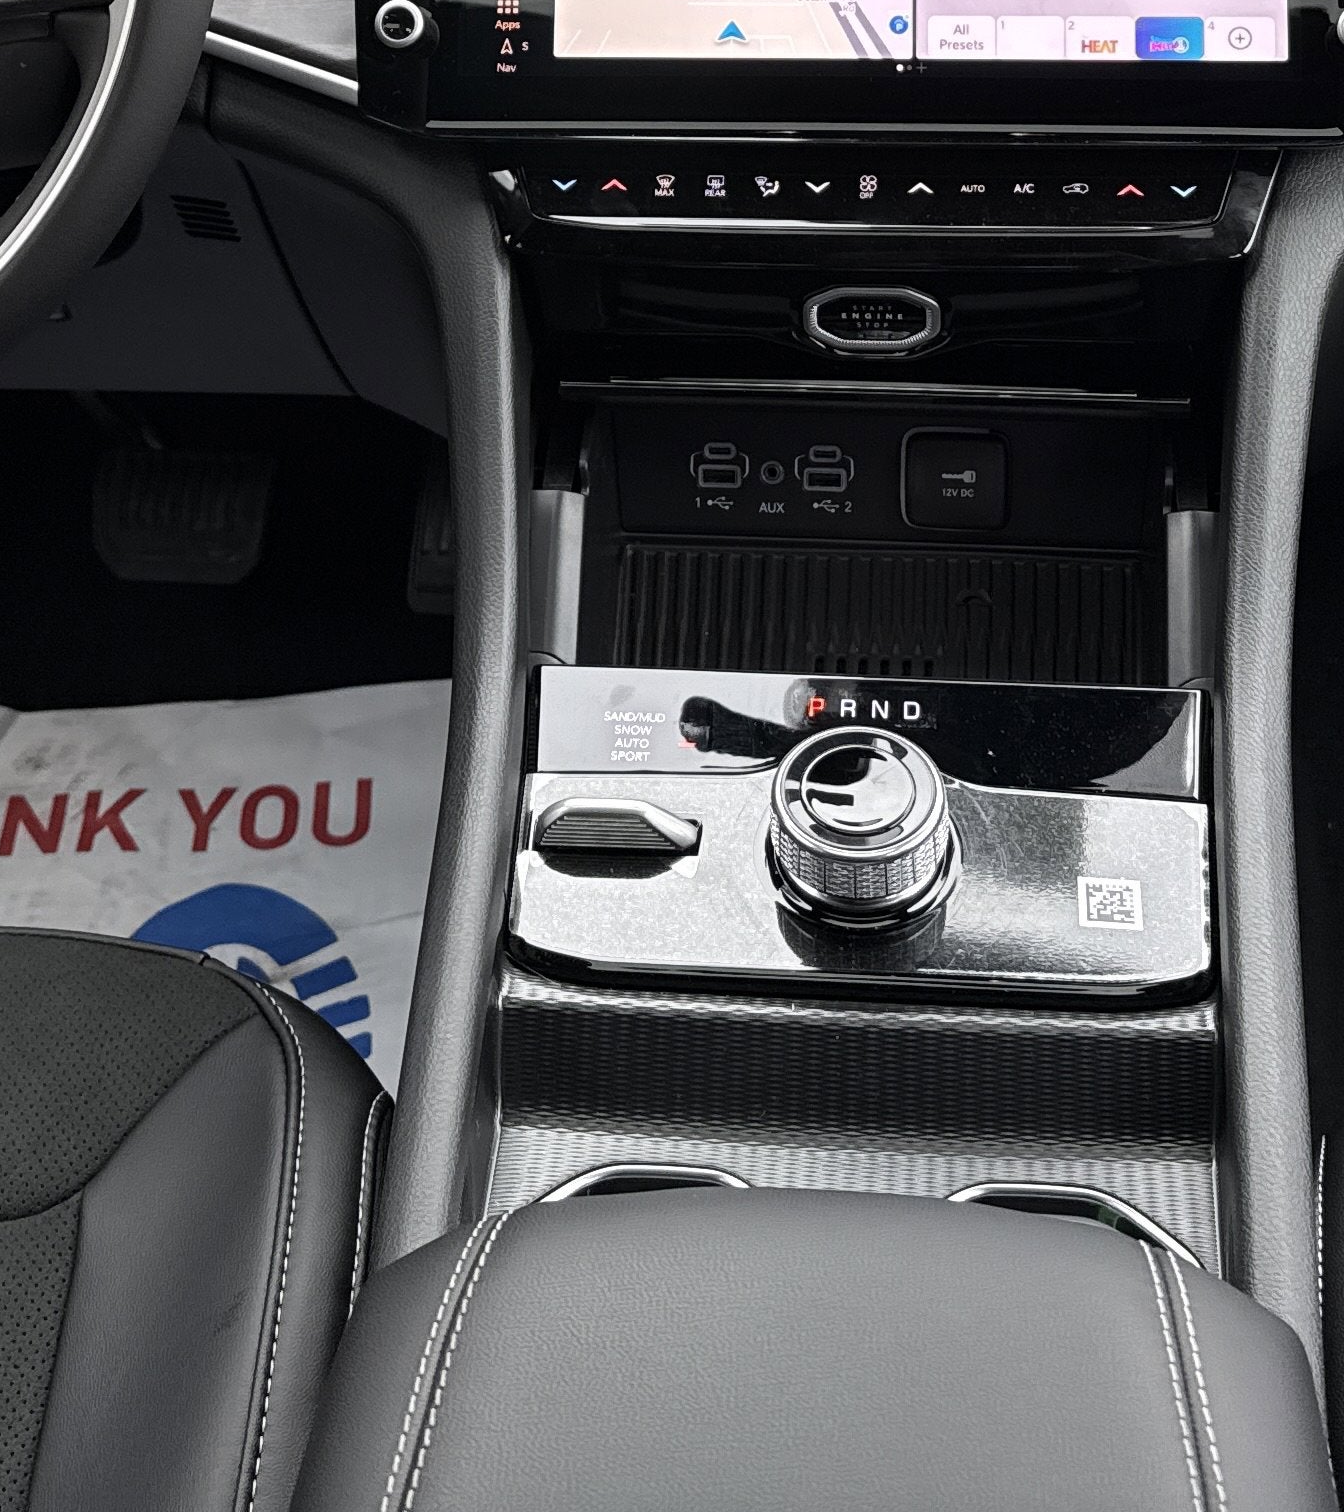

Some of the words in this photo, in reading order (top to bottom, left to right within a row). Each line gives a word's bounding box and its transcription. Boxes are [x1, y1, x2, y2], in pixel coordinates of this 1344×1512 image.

[495, 20, 521, 31] Apps
[953, 24, 969, 35] All
[1068, 21, 1075, 30] 2
[1208, 21, 1215, 31] 4
[939, 39, 984, 51] Presets
[1081, 40, 1118, 53] HEAT
[496, 62, 517, 72] Nav
[654, 189, 675, 197] MAX
[960, 184, 986, 193] AUTO
[1013, 183, 1035, 194] A/C
[841, 312, 903, 320] ENGINE
[960, 488, 975, 498] DC
[695, 497, 701, 508] 1
[759, 502, 785, 514] AUX
[844, 501, 852, 513] 2
[808, 697, 826, 717] P
[840, 698, 856, 718] R
[871, 699, 889, 719] N
[903, 701, 921, 720] D
[603, 711, 666, 723] SAND/MUD
[614, 724, 653, 735] SNOW
[614, 738, 649, 748] AUTO
[610, 750, 651, 762] SPORT
[178, 777, 373, 853] YOU
